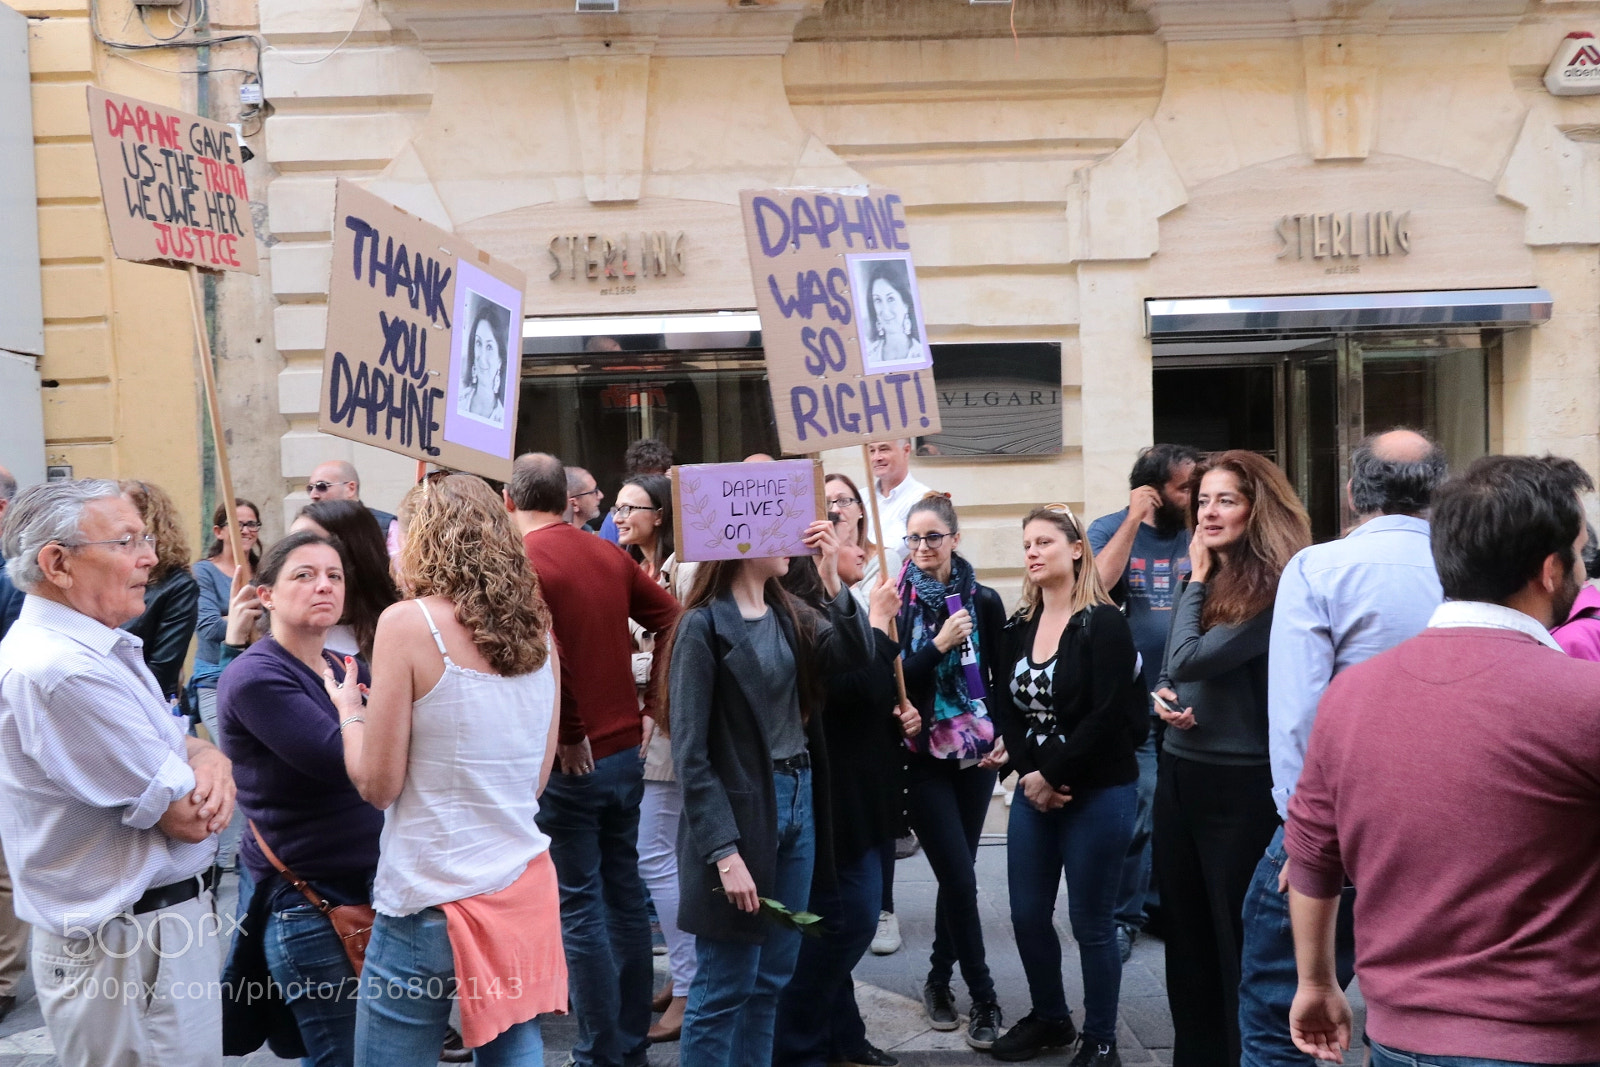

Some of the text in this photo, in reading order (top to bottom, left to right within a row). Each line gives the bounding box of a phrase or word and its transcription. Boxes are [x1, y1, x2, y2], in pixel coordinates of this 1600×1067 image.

[1564, 67, 1600, 77] albert
[105, 99, 235, 164] DAPHNE GAVE
[123, 177, 244, 237] WE OWE HER
[753, 194, 910, 258] DAPHNE
[153, 222, 241, 266] JUSTICE
[549, 231, 685, 280] STERLING
[1275, 210, 1411, 260] STERLING
[345, 215, 452, 329] THANK
[767, 268, 852, 325] WAS
[801, 326, 847, 376] SO
[330, 352, 444, 456] DAPHNE
[790, 371, 930, 441] RIGHT!
[942, 390, 1058, 406] VLGARI
[722, 478, 788, 497] DAPHNE
[731, 499, 785, 516] LIVES
